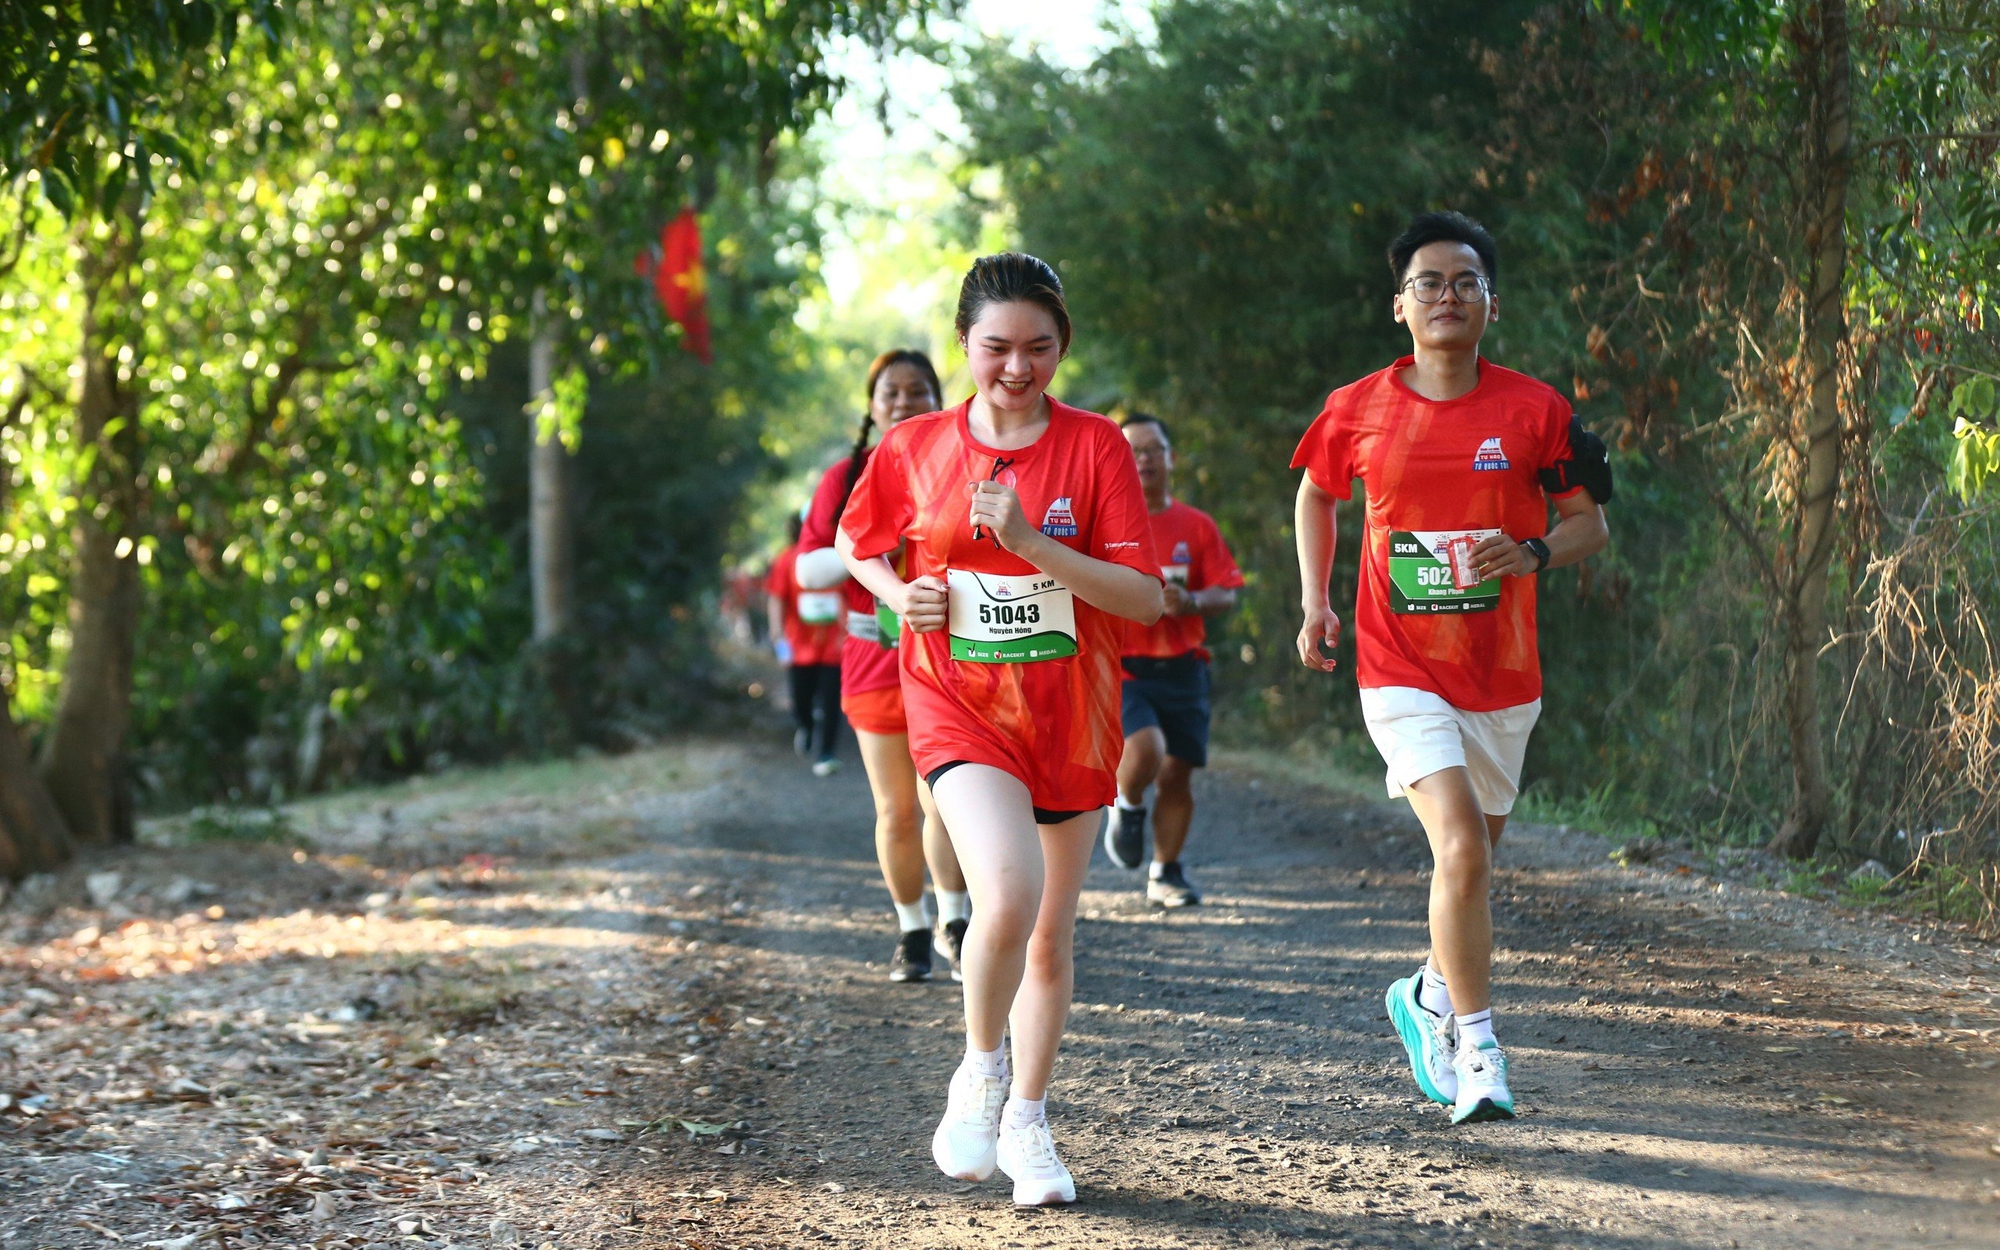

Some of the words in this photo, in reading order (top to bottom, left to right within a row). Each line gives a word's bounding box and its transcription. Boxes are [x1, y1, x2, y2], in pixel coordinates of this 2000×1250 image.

[1395, 543, 1418, 553] 5KM
[1041, 580, 1055, 590] KM
[980, 603, 1040, 624] 51043
